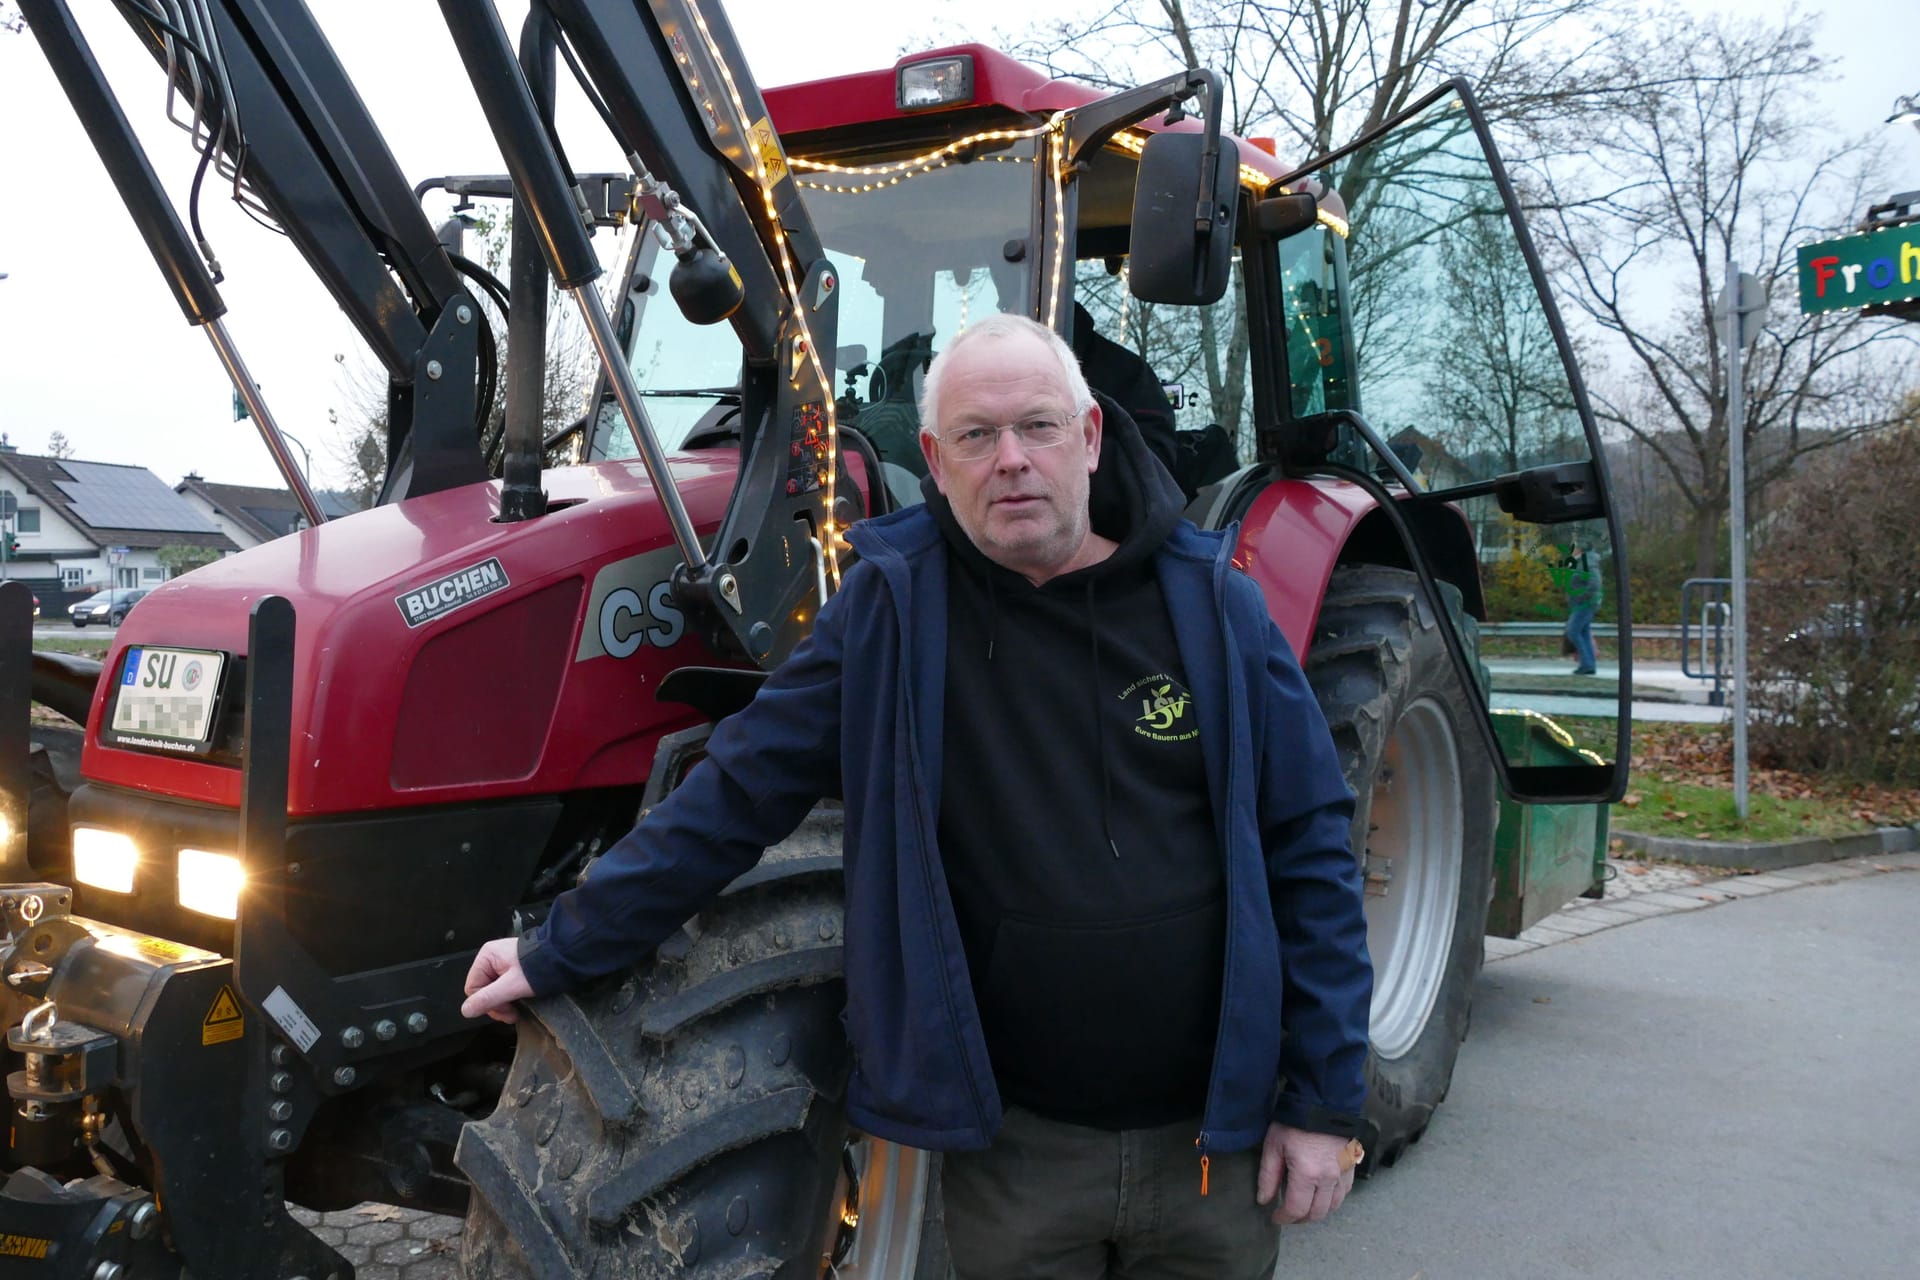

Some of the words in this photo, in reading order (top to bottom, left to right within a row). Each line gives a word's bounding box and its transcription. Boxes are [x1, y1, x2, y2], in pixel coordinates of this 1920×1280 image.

[406, 562, 499, 618] BUCHEN
[598, 580, 685, 659] CS
[127, 671, 134, 684] D
[142, 652, 177, 689] SU
[1118, 683, 1136, 700] Land
[1142, 695, 1184, 729] LSV
[116, 735, 195, 752] www.landtechnik-buchen.de
[1134, 725, 1152, 738] Eure
[1152, 732, 1178, 741] Bauern
